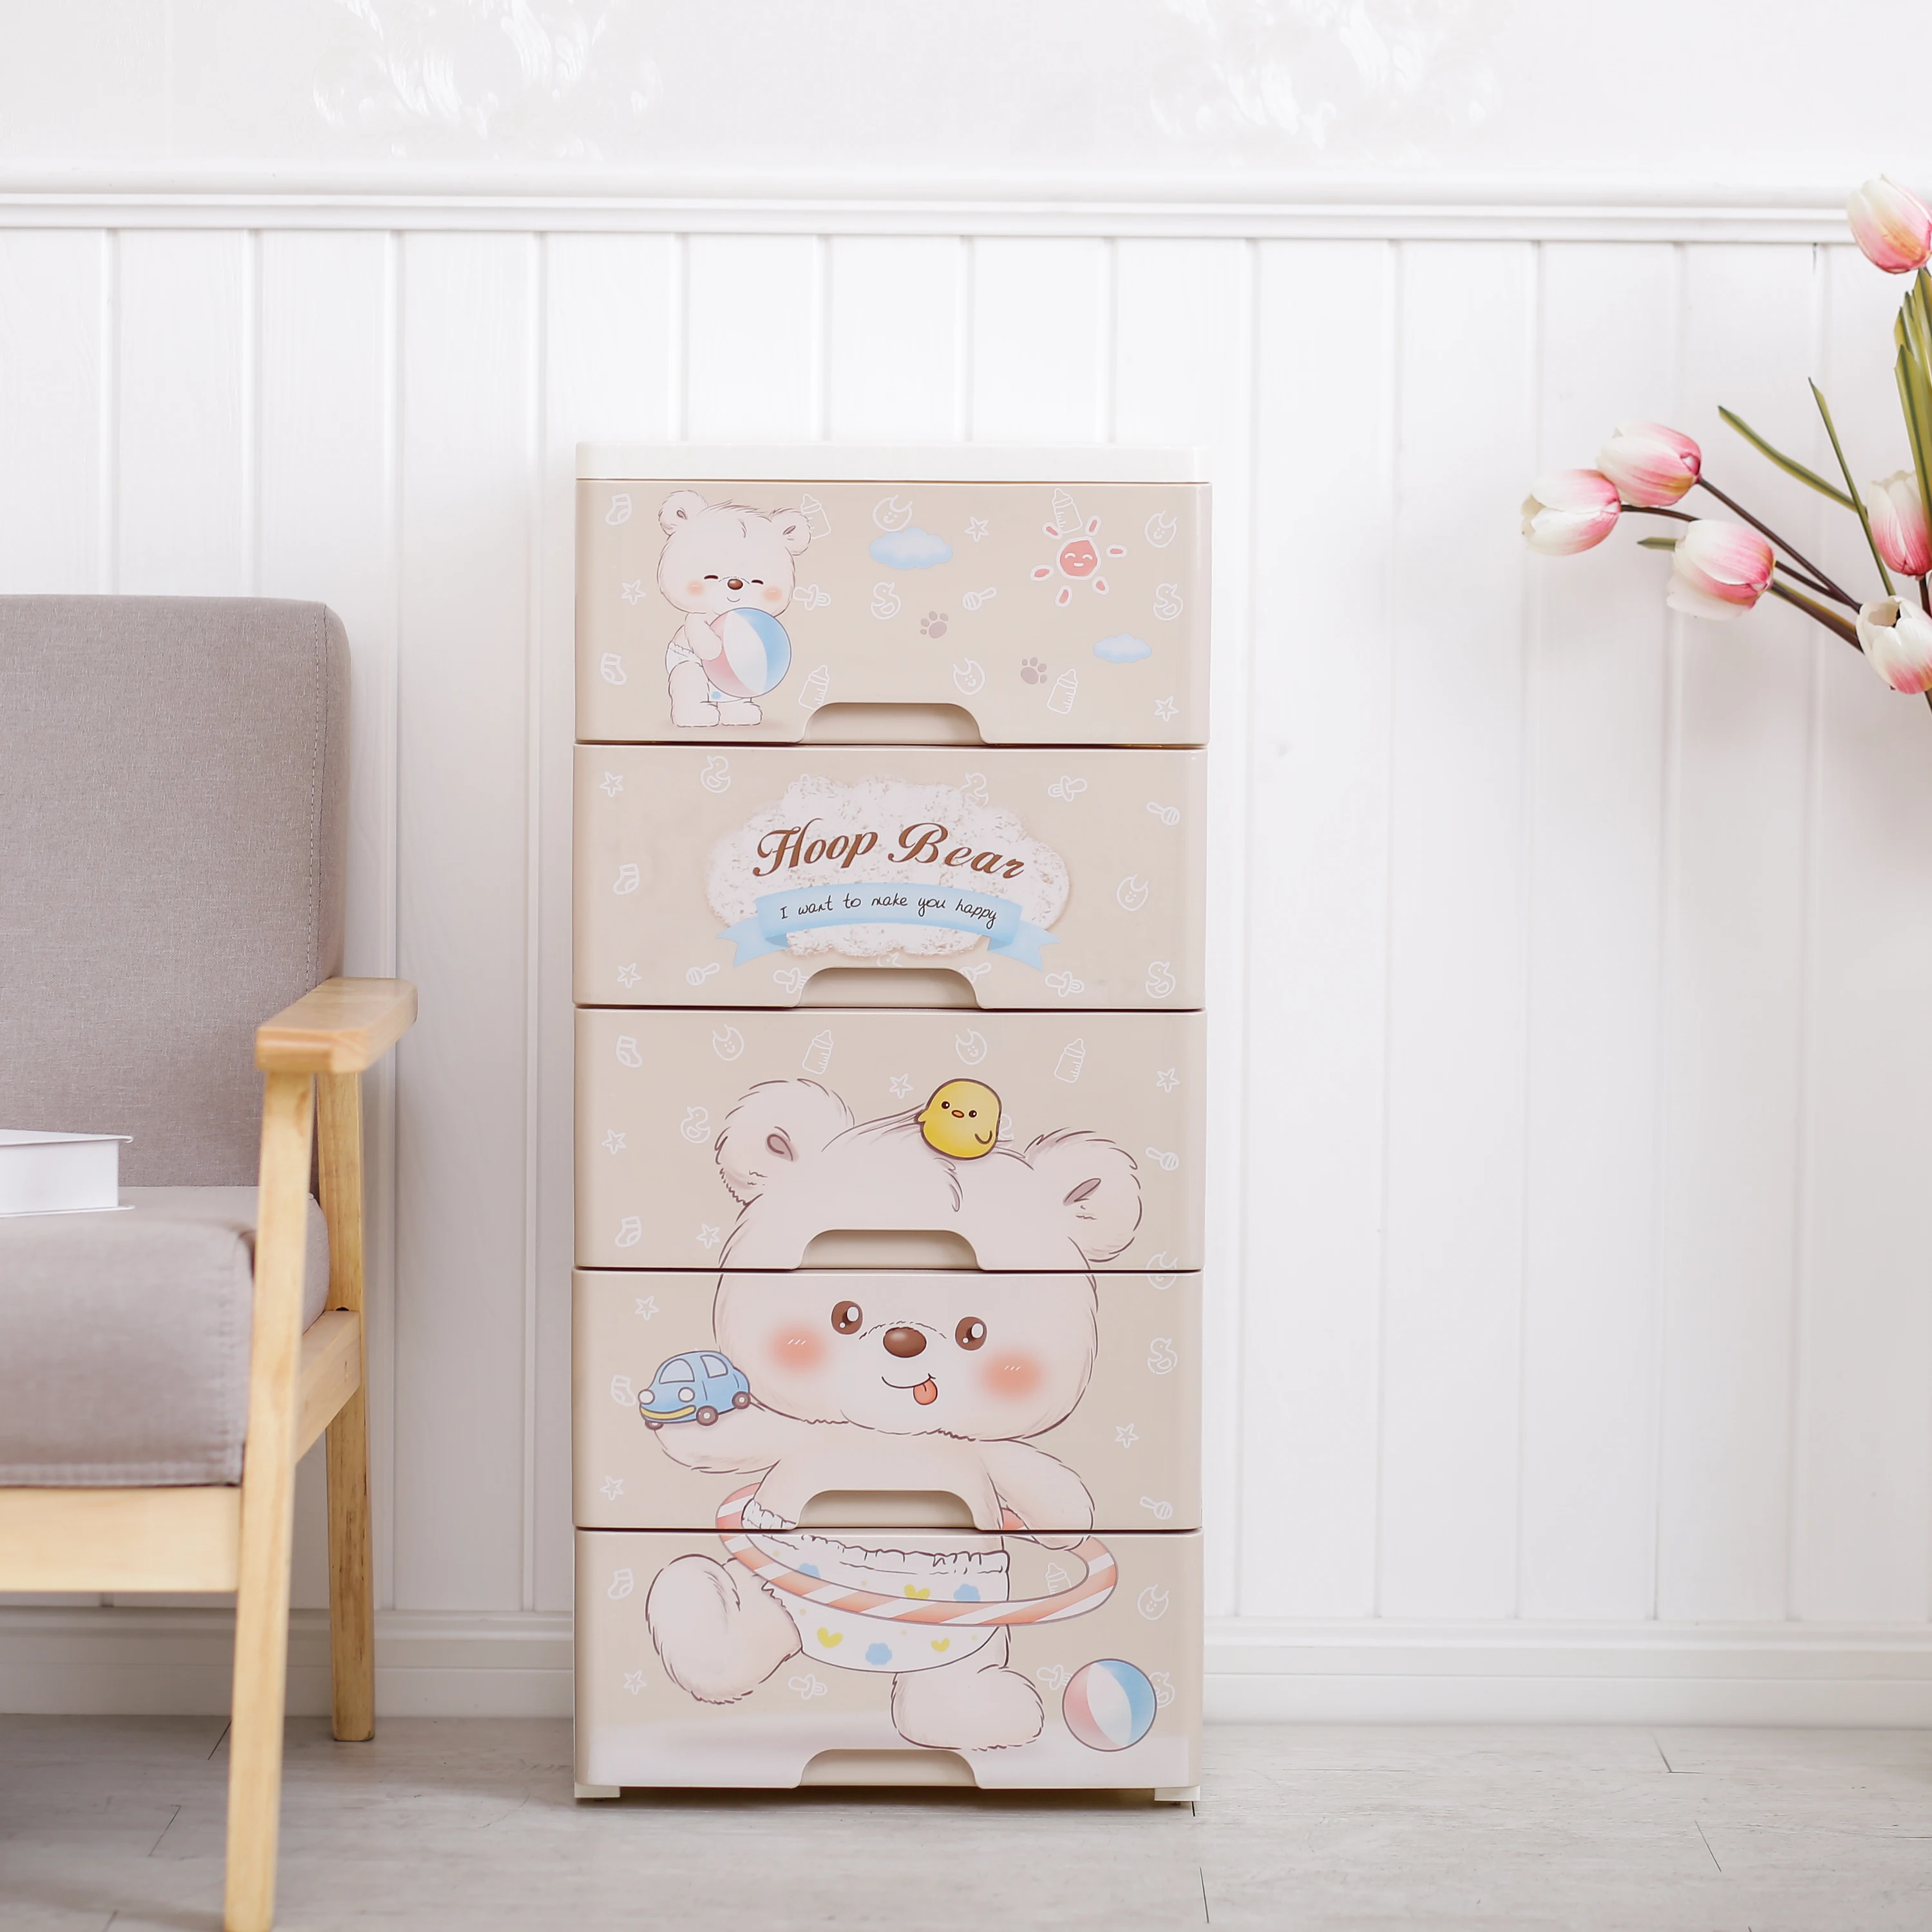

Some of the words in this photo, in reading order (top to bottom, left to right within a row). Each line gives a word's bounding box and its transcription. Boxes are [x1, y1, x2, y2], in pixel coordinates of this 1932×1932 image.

[752, 817, 878, 877] Hoop
[887, 822, 1025, 879] Bear
[780, 905, 788, 920] I
[797, 895, 834, 915] want
[842, 893, 862, 909] to
[871, 893, 909, 907] make
[918, 896, 946, 917] you
[955, 898, 998, 931] happy
